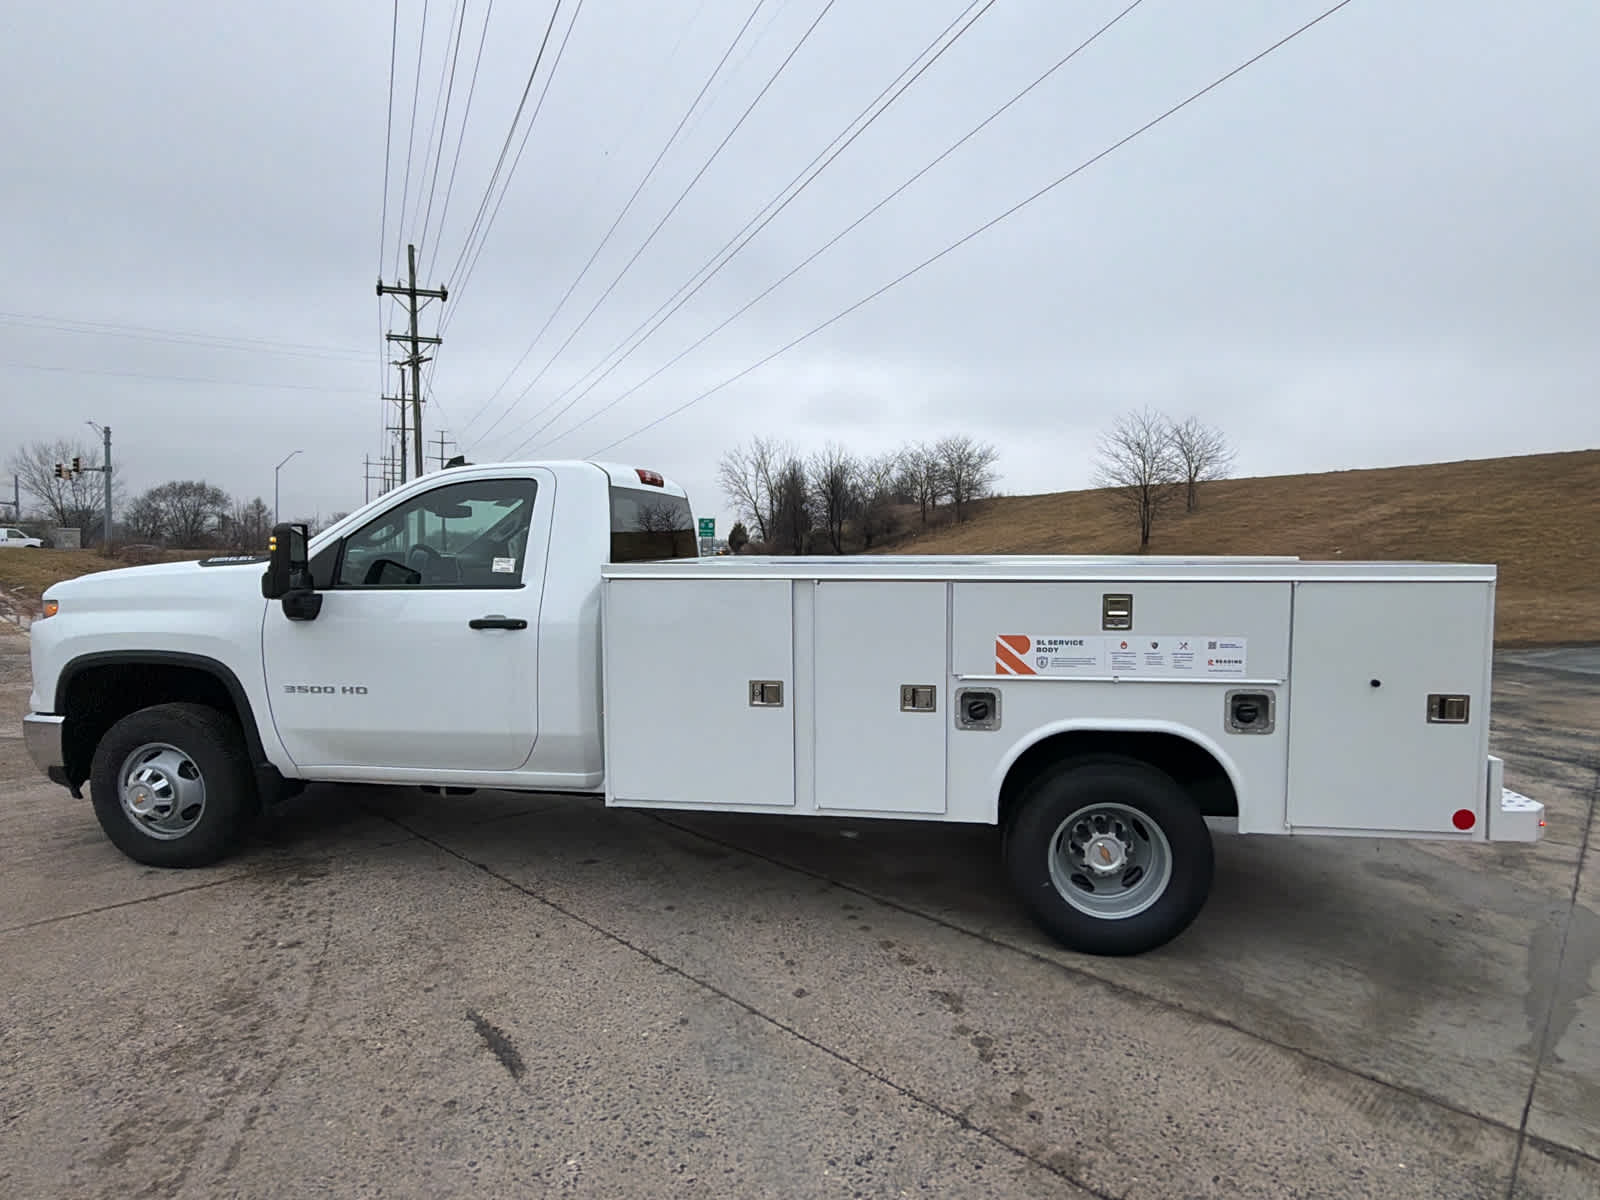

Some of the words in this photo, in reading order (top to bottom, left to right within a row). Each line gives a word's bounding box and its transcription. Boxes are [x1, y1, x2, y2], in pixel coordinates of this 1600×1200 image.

[1047, 639, 1084, 647] SERVICE
[283, 685, 336, 694] 3500
[341, 686, 368, 695] HD
